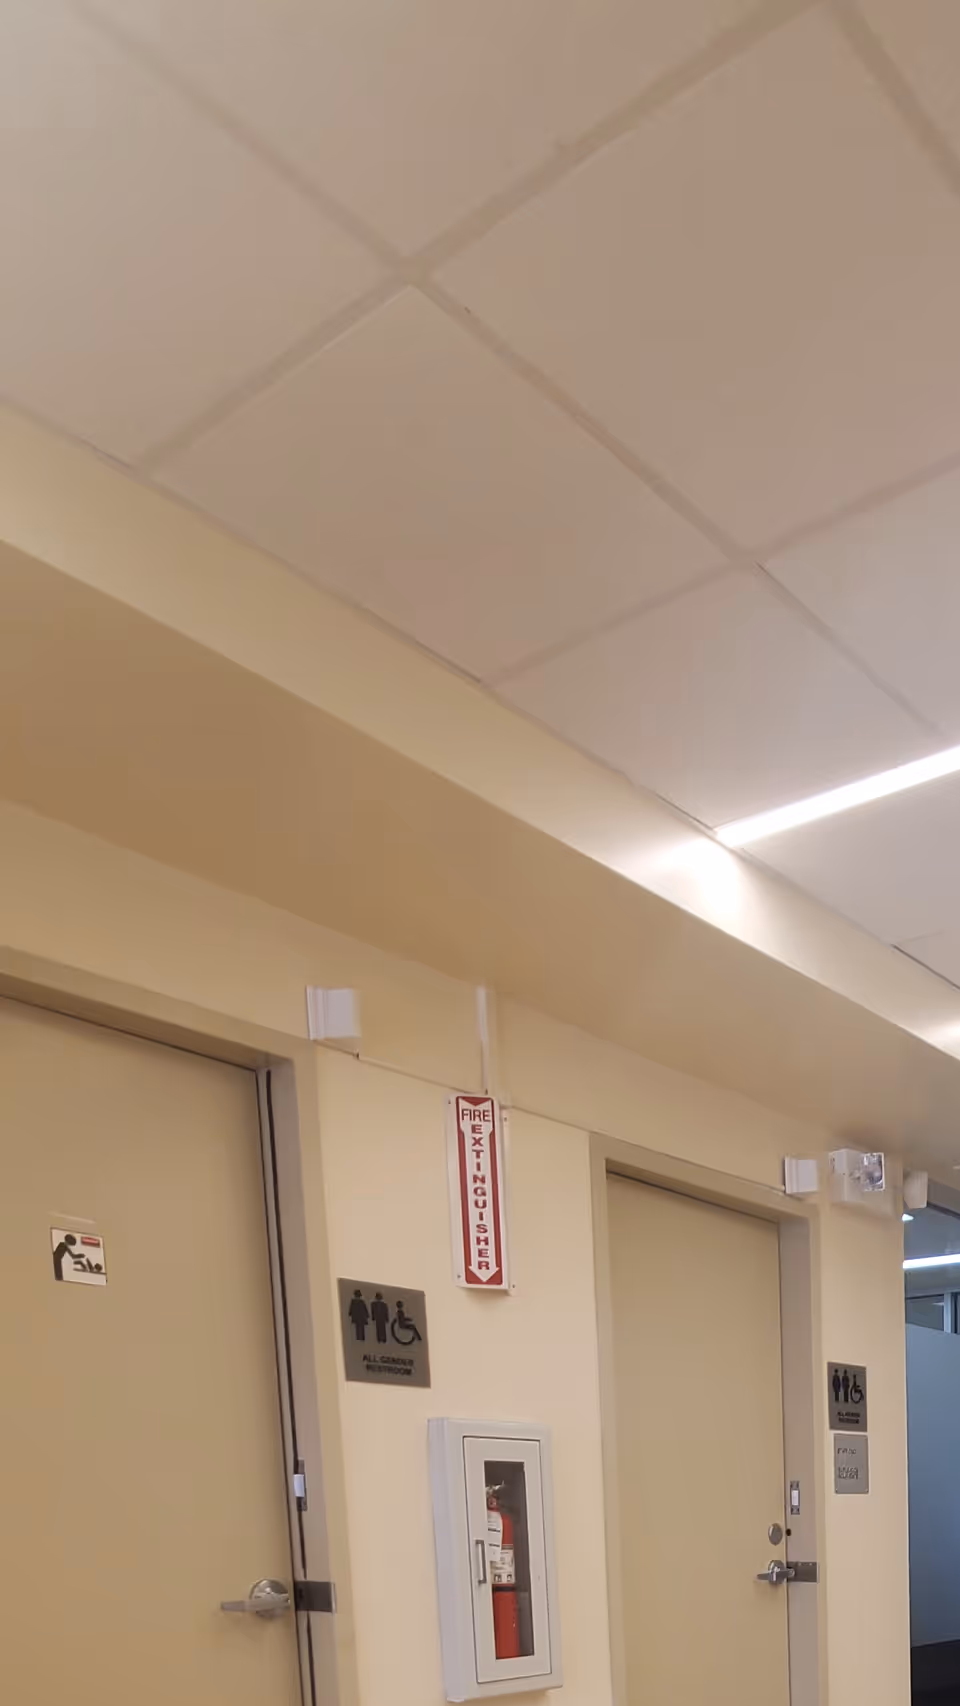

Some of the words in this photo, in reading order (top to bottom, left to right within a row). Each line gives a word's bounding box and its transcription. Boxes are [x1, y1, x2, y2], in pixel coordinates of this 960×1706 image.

[461, 1109, 491, 1122] FIRE
[471, 1124, 490, 1271] EXTINGUISHER
[363, 1354, 379, 1362] ALL
